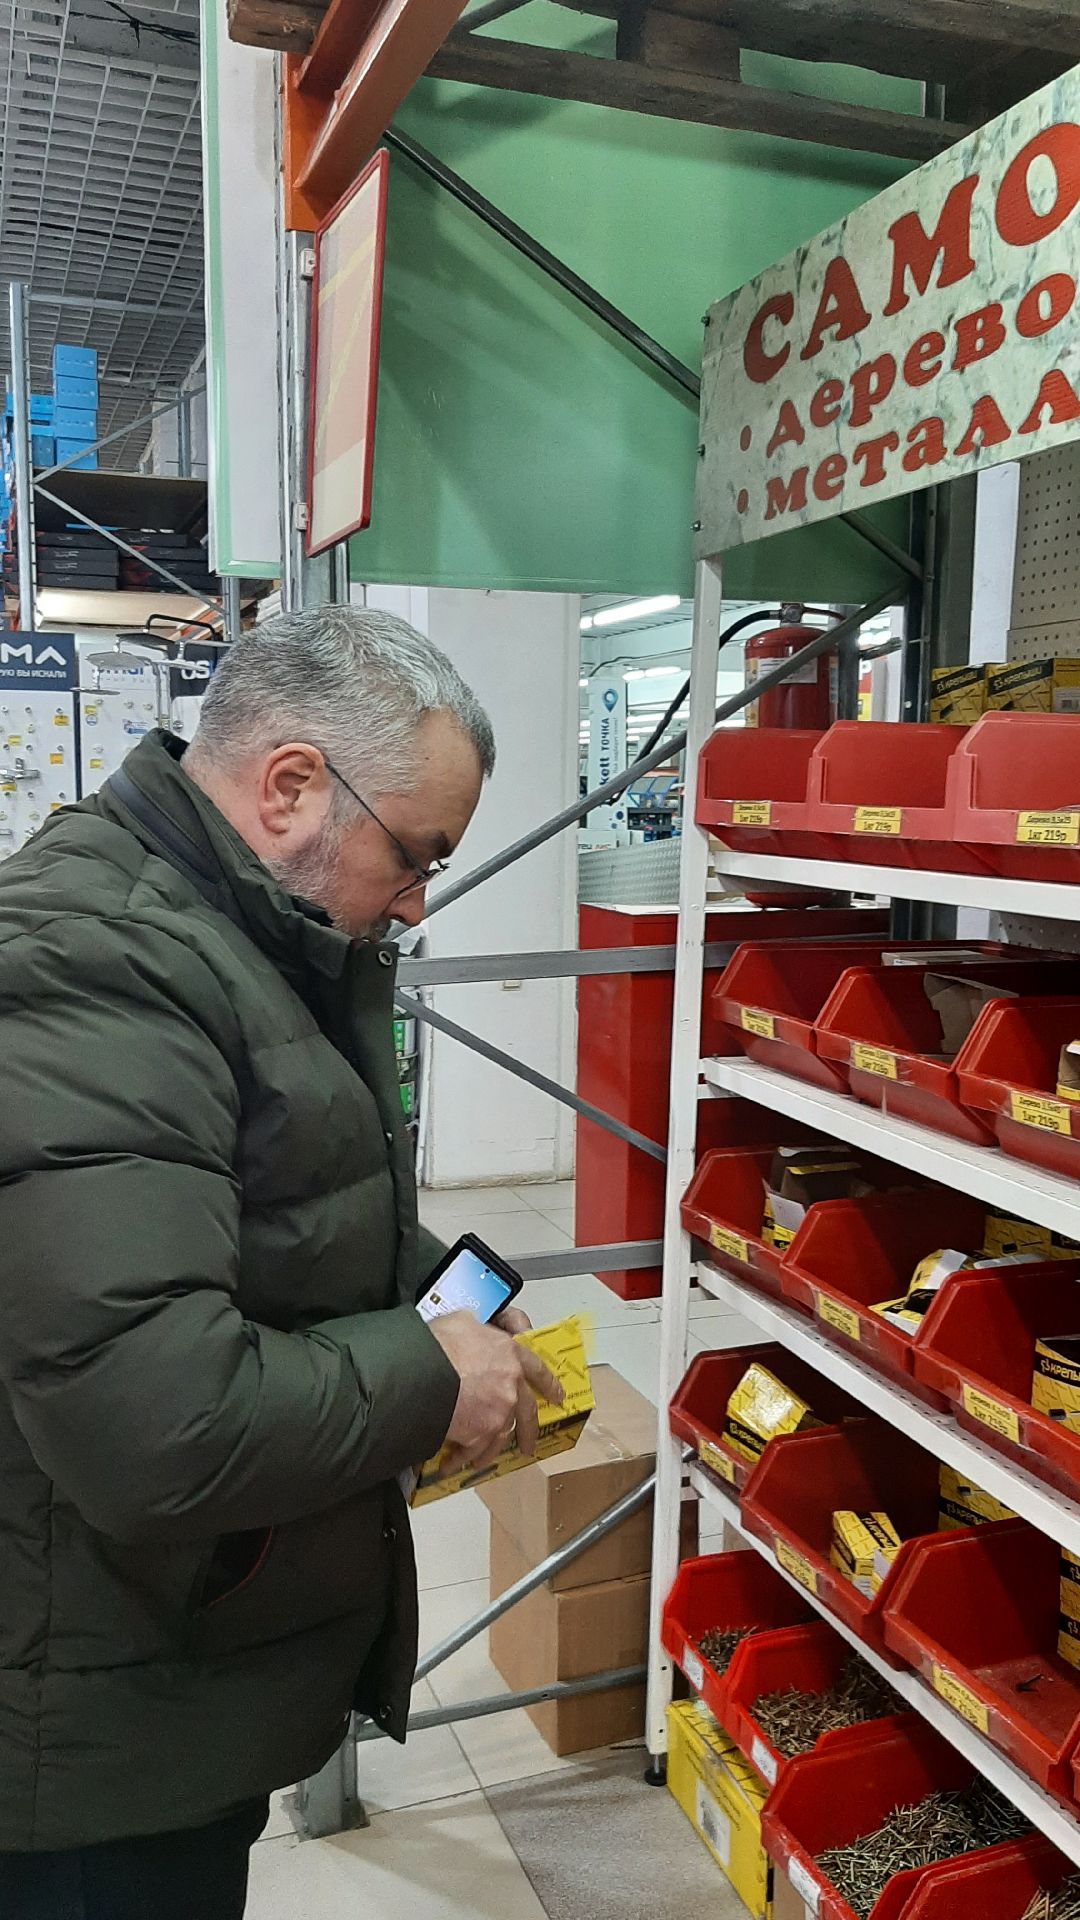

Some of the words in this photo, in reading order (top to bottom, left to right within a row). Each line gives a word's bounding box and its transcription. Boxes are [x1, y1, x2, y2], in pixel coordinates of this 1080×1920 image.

[743, 121, 1080, 384] САМО
[766, 273, 1076, 458] дерево
[16, 669, 31, 678] ВЫ
[32, 669, 67, 679] ИСКАЛИ
[1027, 829, 1042, 841] 1кг
[1043, 829, 1067, 842] 219р
